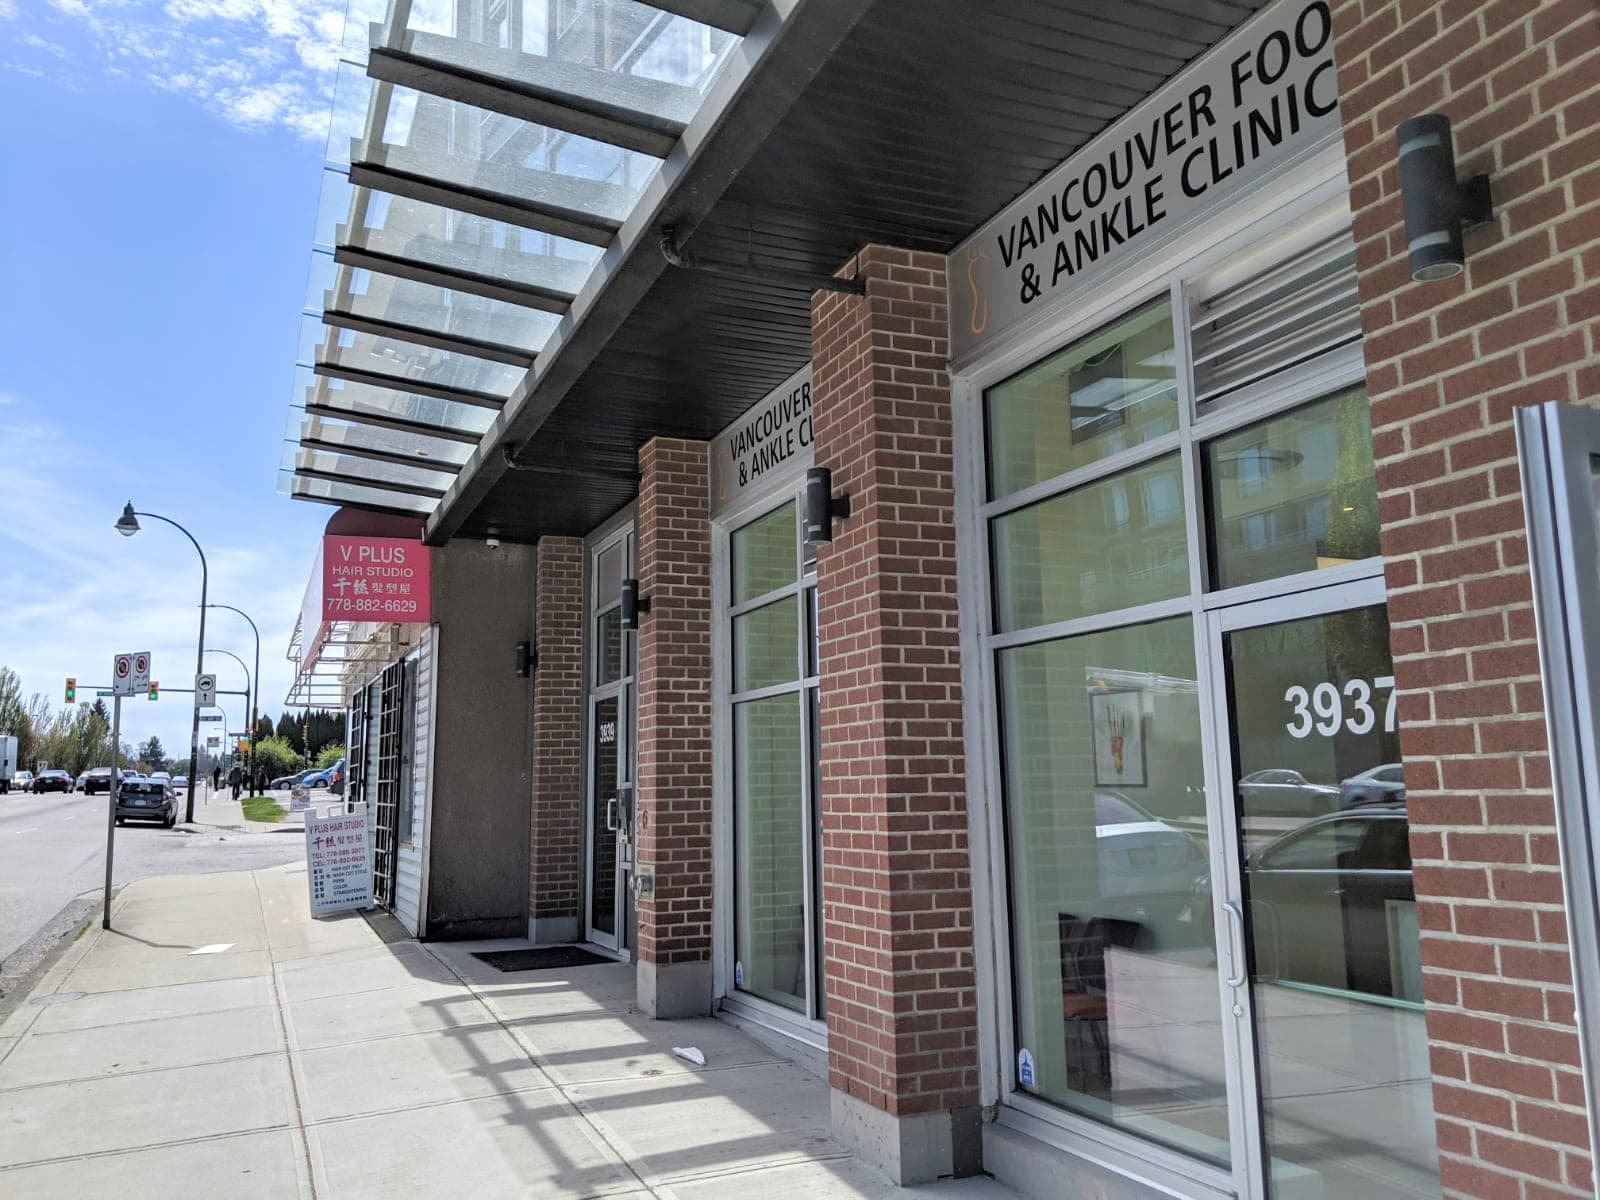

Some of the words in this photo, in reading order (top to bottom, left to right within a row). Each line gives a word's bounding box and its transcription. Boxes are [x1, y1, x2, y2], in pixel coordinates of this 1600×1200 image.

[998, 84, 1217, 268] VANCOUVER
[1230, 0, 1332, 108] FOO
[1020, 263, 1042, 304] &
[1051, 175, 1167, 287] ANKLE
[1181, 59, 1338, 197] CLINIC
[730, 382, 811, 461] VANCOUVER
[739, 461, 748, 487] &
[751, 428, 794, 480] ANKLE
[332, 566, 363, 576] HAIR
[367, 566, 414, 578] STUDIO
[340, 545, 352, 561] V
[359, 546, 405, 564] PLUS
[327, 598, 417, 613] 778-882-6629
[1284, 676, 1397, 738] 3937
[309, 825, 314, 834] V
[314, 823, 329, 833] PLUS
[329, 822, 343, 832] HAIR
[344, 819, 364, 830] STUDIO
